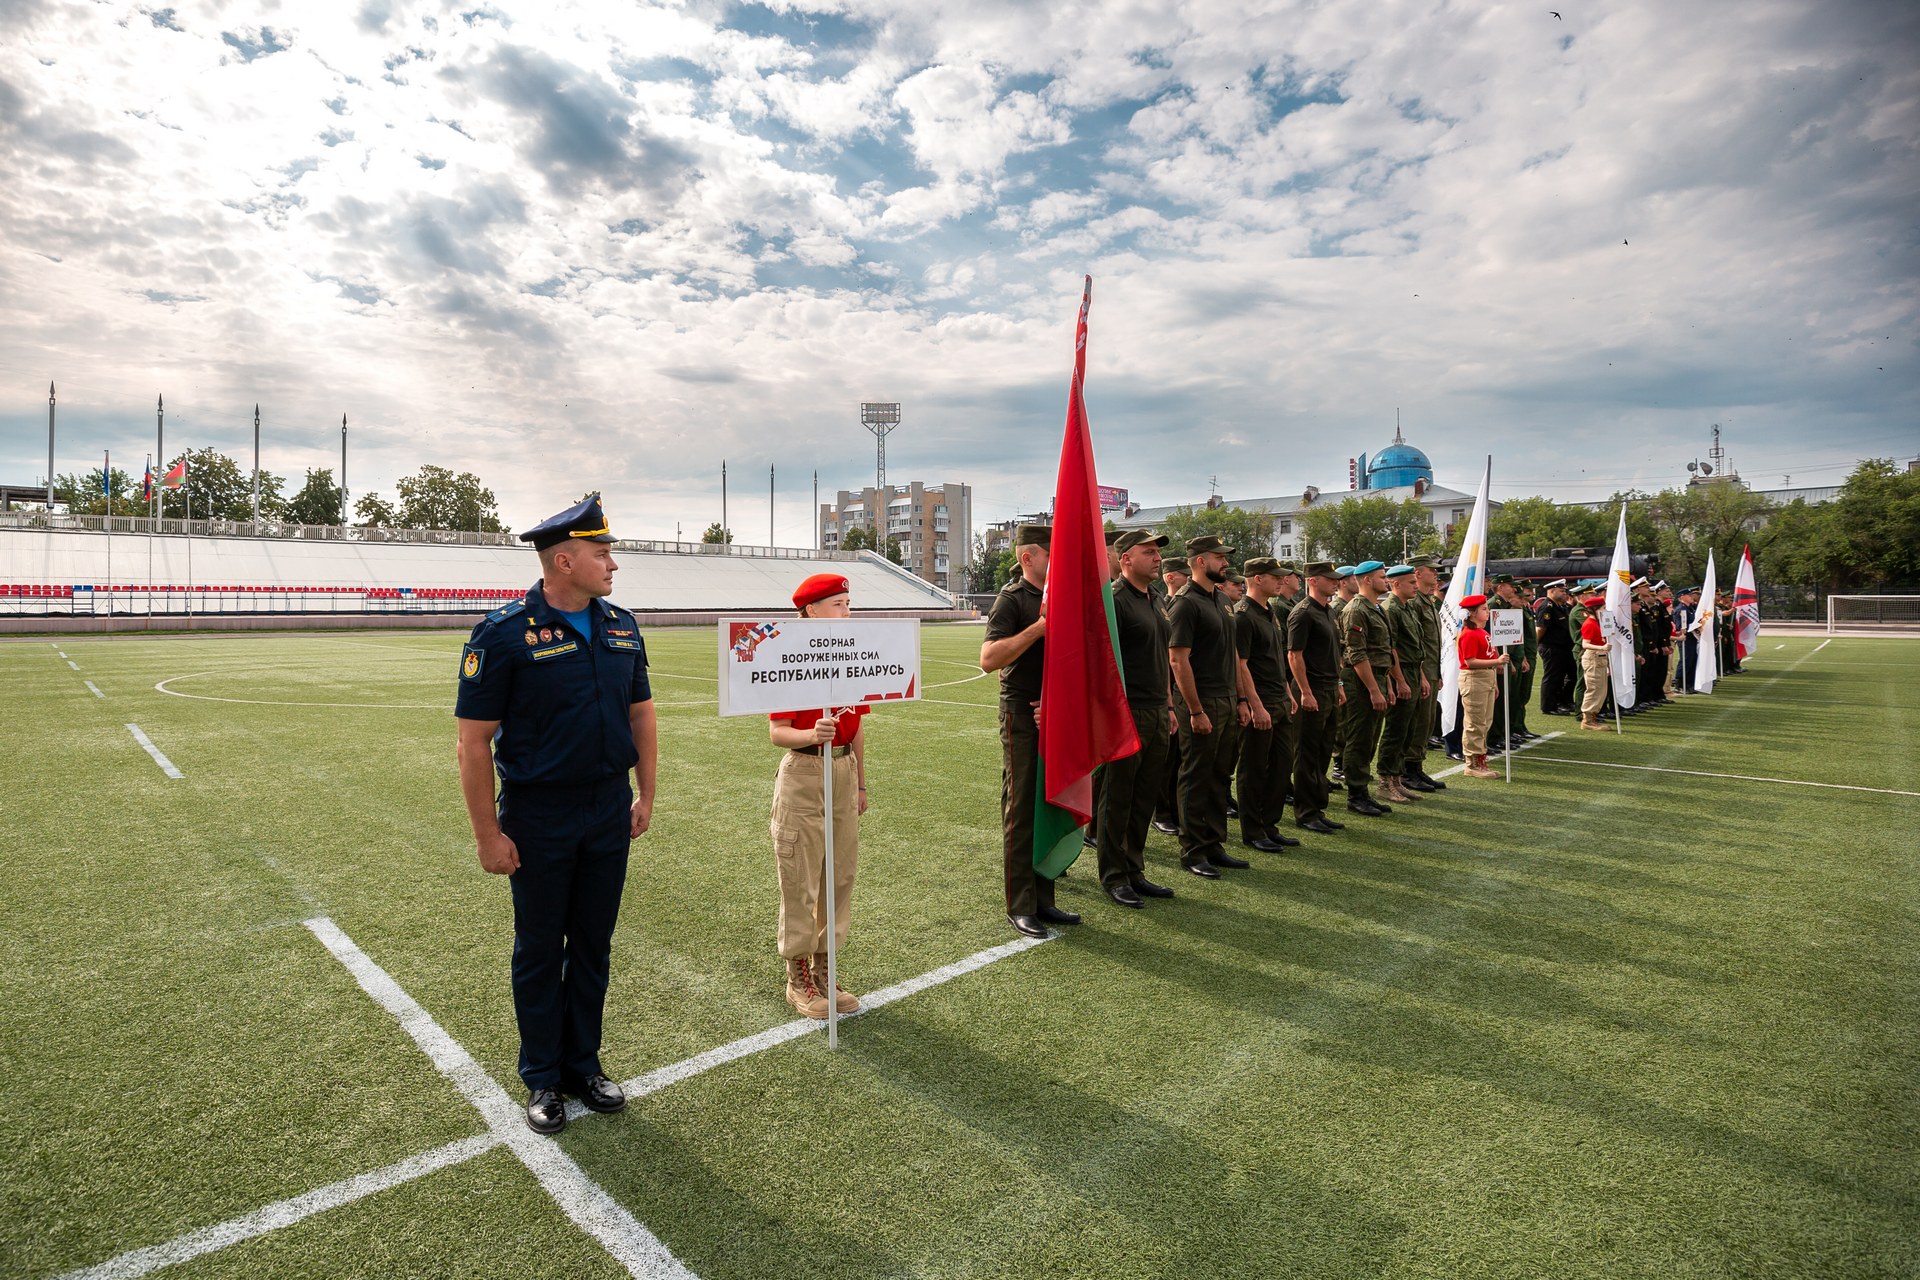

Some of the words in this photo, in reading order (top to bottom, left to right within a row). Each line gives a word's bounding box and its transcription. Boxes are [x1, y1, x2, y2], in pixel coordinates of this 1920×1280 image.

[809, 638, 855, 648] СБОРНАЯ
[781, 652, 859, 664] ВООРУЖЕННЫХ
[860, 651, 880, 661] СИЛ
[751, 667, 840, 684] РЕСПУБЛИКИ
[846, 664, 904, 678] БЕЛАРУСЬ
